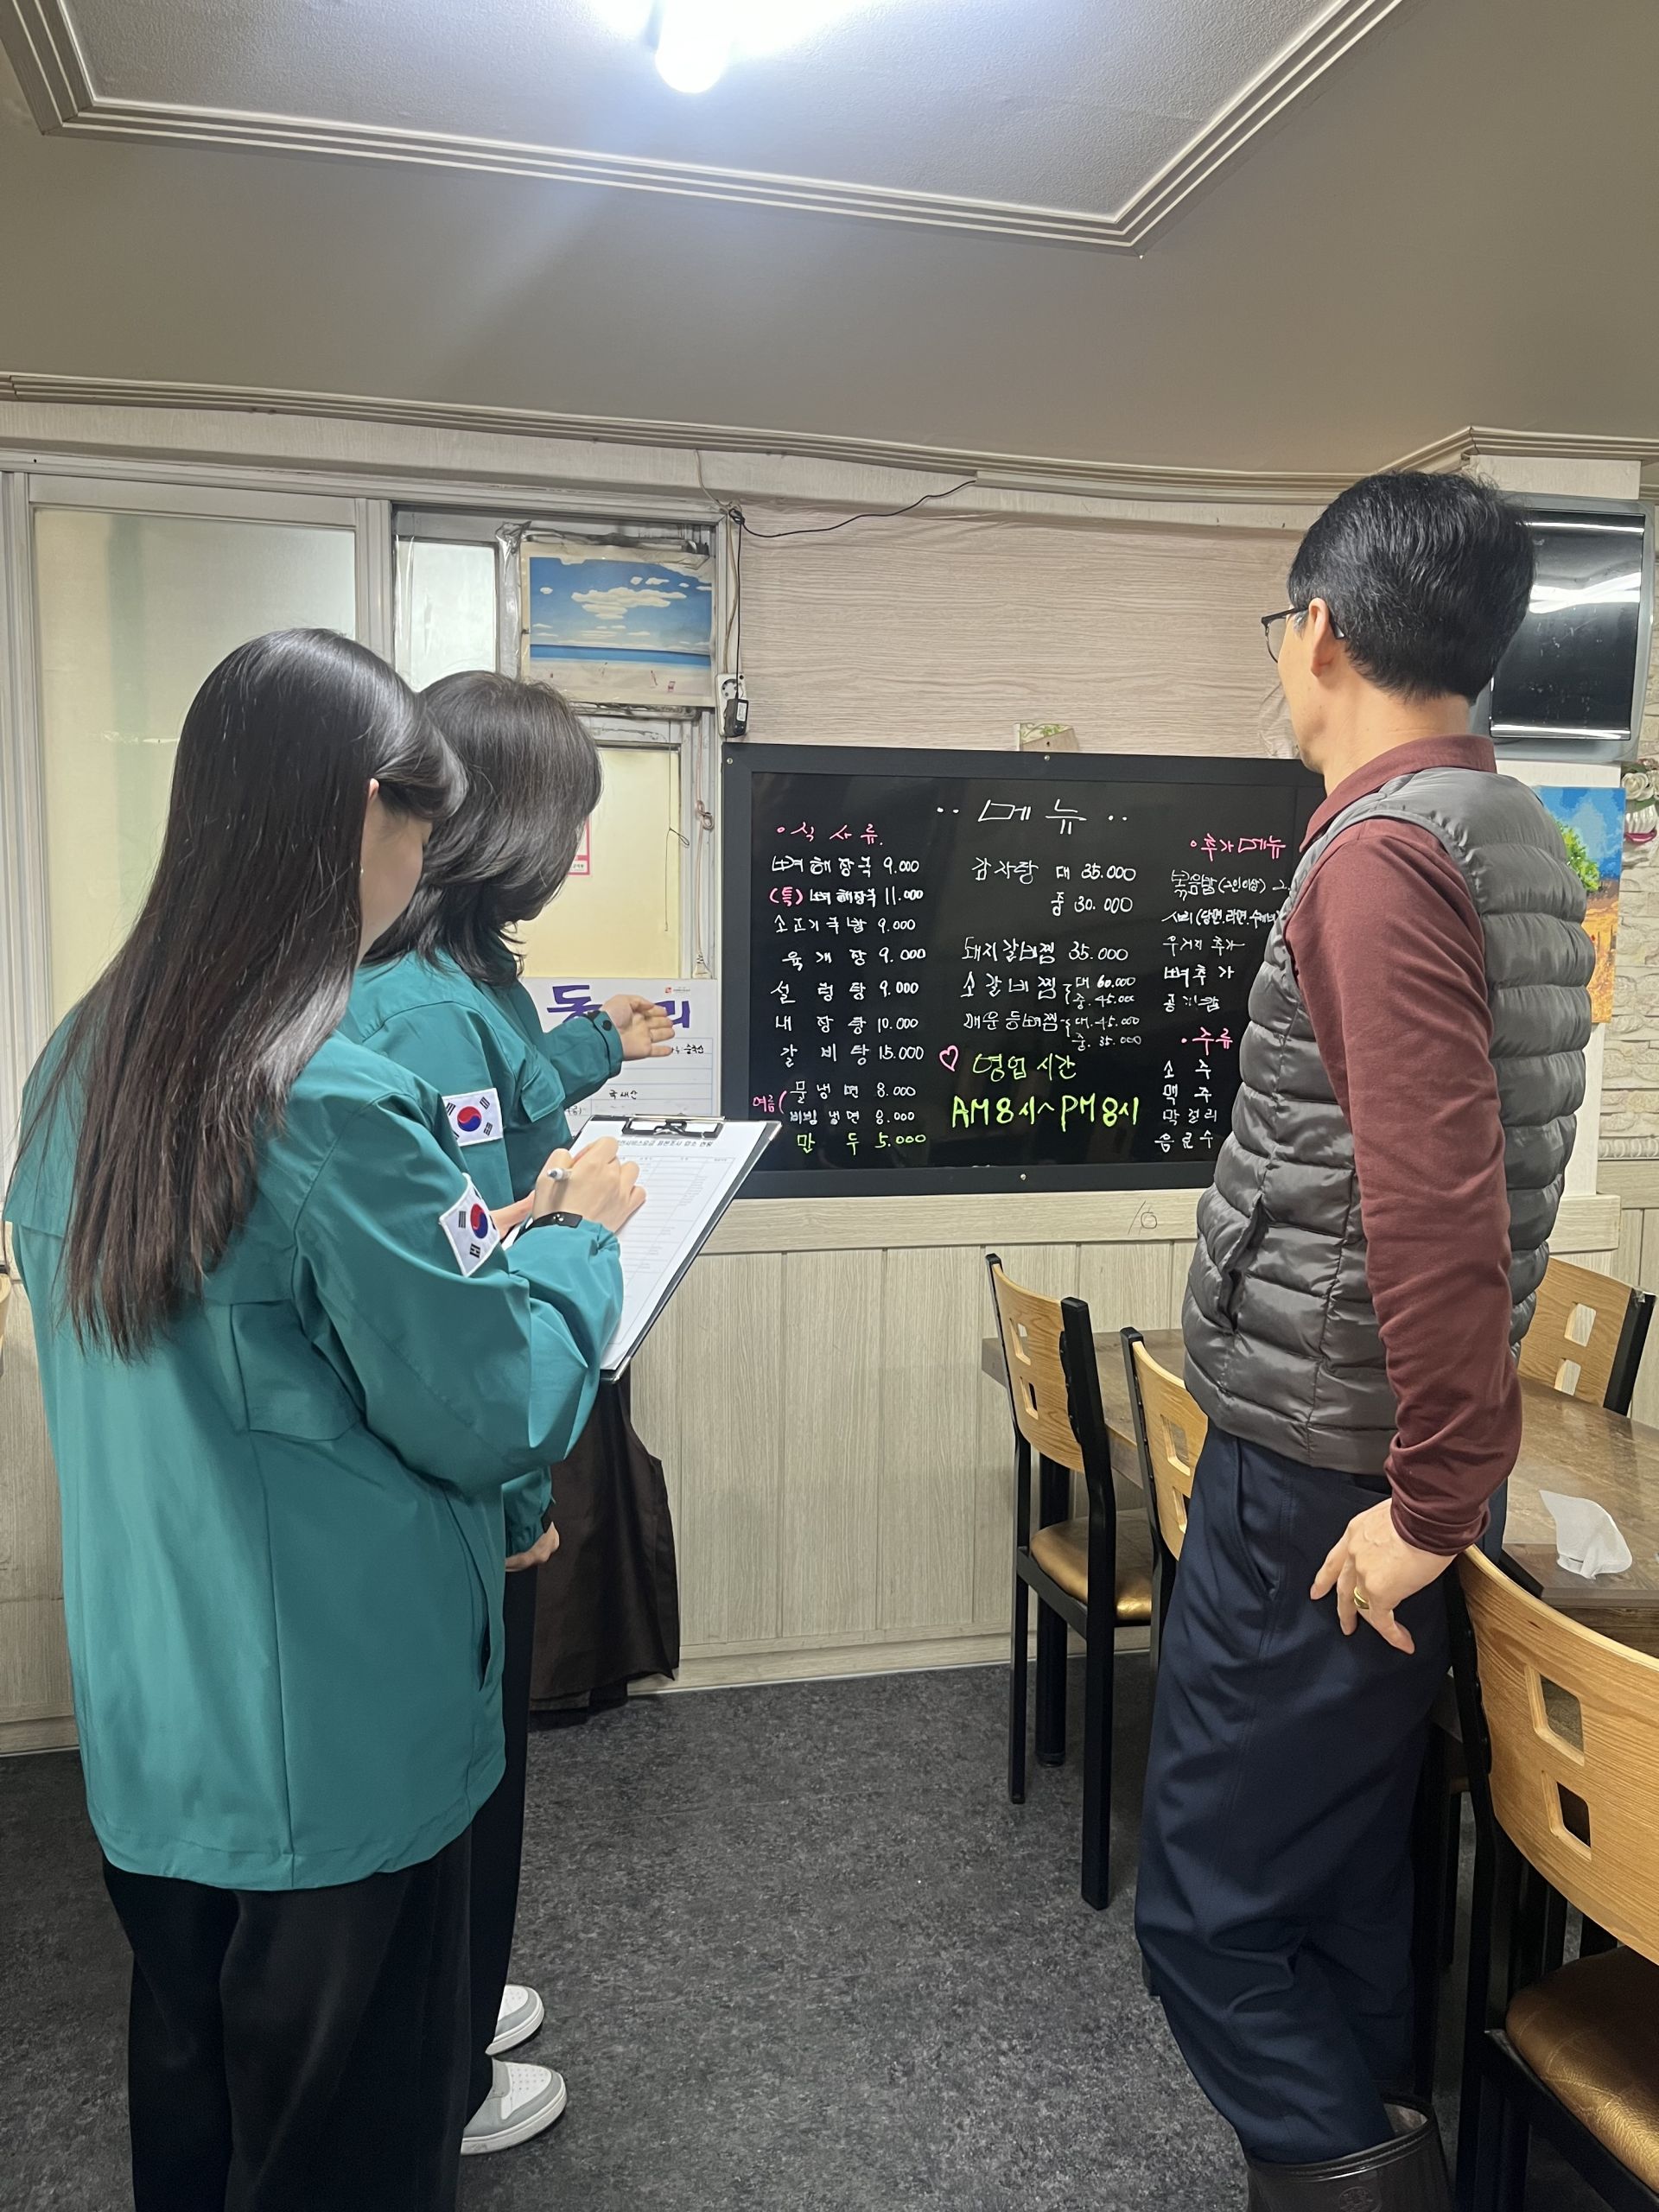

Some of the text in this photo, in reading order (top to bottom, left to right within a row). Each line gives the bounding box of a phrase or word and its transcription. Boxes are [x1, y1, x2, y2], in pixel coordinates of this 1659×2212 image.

[977, 798, 1088, 836] 메뉴
[883, 856, 920, 875] 9.000
[971, 856, 1137, 885] 감자탕 대 35.000
[769, 886, 804, 907] (특)
[885, 886, 924, 906] 11.000
[1050, 891, 1134, 917] 중 30.000
[877, 917, 916, 934] 9.000
[878, 946, 926, 964] 9.000
[961, 936, 1128, 965] 돼지갈비찜 35.000
[879, 980, 919, 998] 9.000
[960, 970, 1057, 1001] 소갈비찜
[877, 1017, 919, 1033] 10.000
[879, 1044, 925, 1060] 15.000
[1192, 1027, 1234, 1056] 주류
[972, 1052, 1077, 1083] 영업 시간
[1163, 1058, 1211, 1080] 소주
[876, 1082, 917, 1098] 8.000
[1162, 1084, 1212, 1106] 맥주
[875, 1109, 915, 1125] 8.000
[1162, 1108, 1217, 1126] 막걸리
[874, 1131, 926, 1148] 5.000
[1154, 1129, 1214, 1154] 음료수
